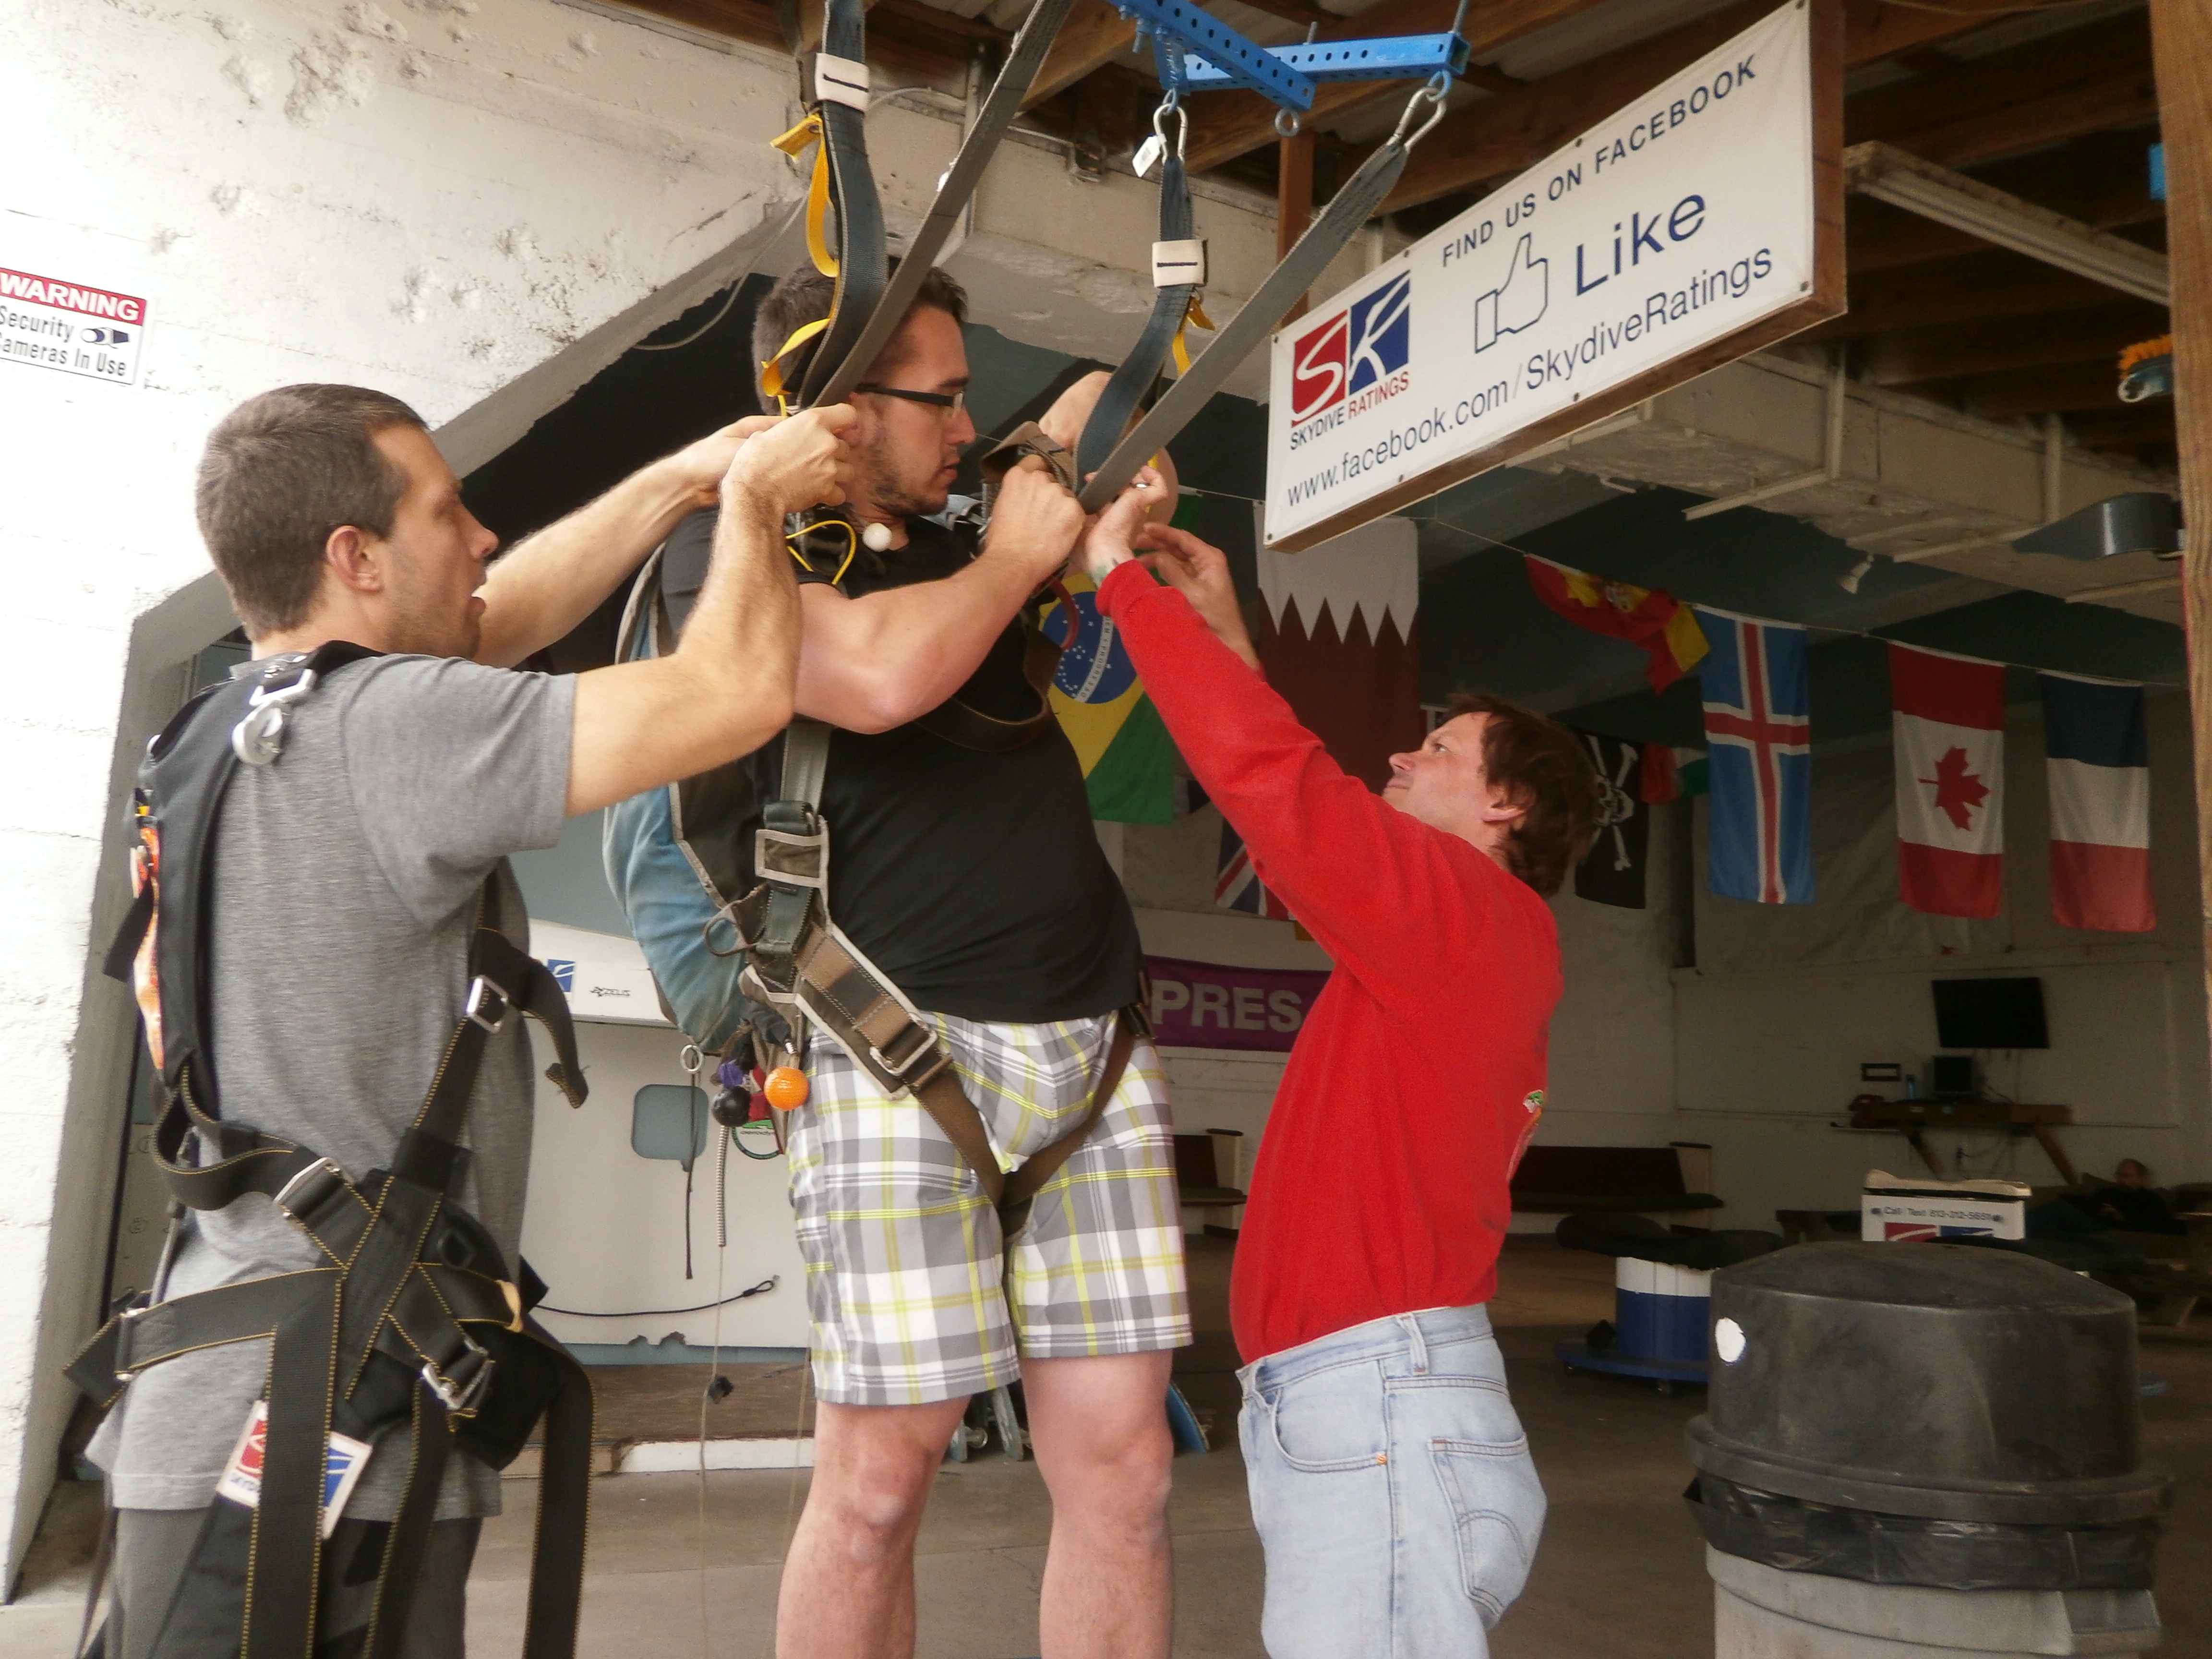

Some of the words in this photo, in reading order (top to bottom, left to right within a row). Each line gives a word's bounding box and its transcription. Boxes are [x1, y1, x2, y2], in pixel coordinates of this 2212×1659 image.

[1442, 219, 1493, 267] FIND
[1505, 192, 1536, 228] US
[1548, 163, 1582, 202] ON
[1595, 54, 1756, 174] FACEBOOK
[1575, 193, 1706, 297] Like
[0, 272, 140, 321] WARNING
[0, 305, 73, 343] Security
[0, 332, 68, 365] ameras
[74, 348, 90, 369] In
[96, 352, 126, 377] Use
[1290, 406, 1345, 450] SKYDIVE
[1348, 370, 1409, 420] RATINGS
